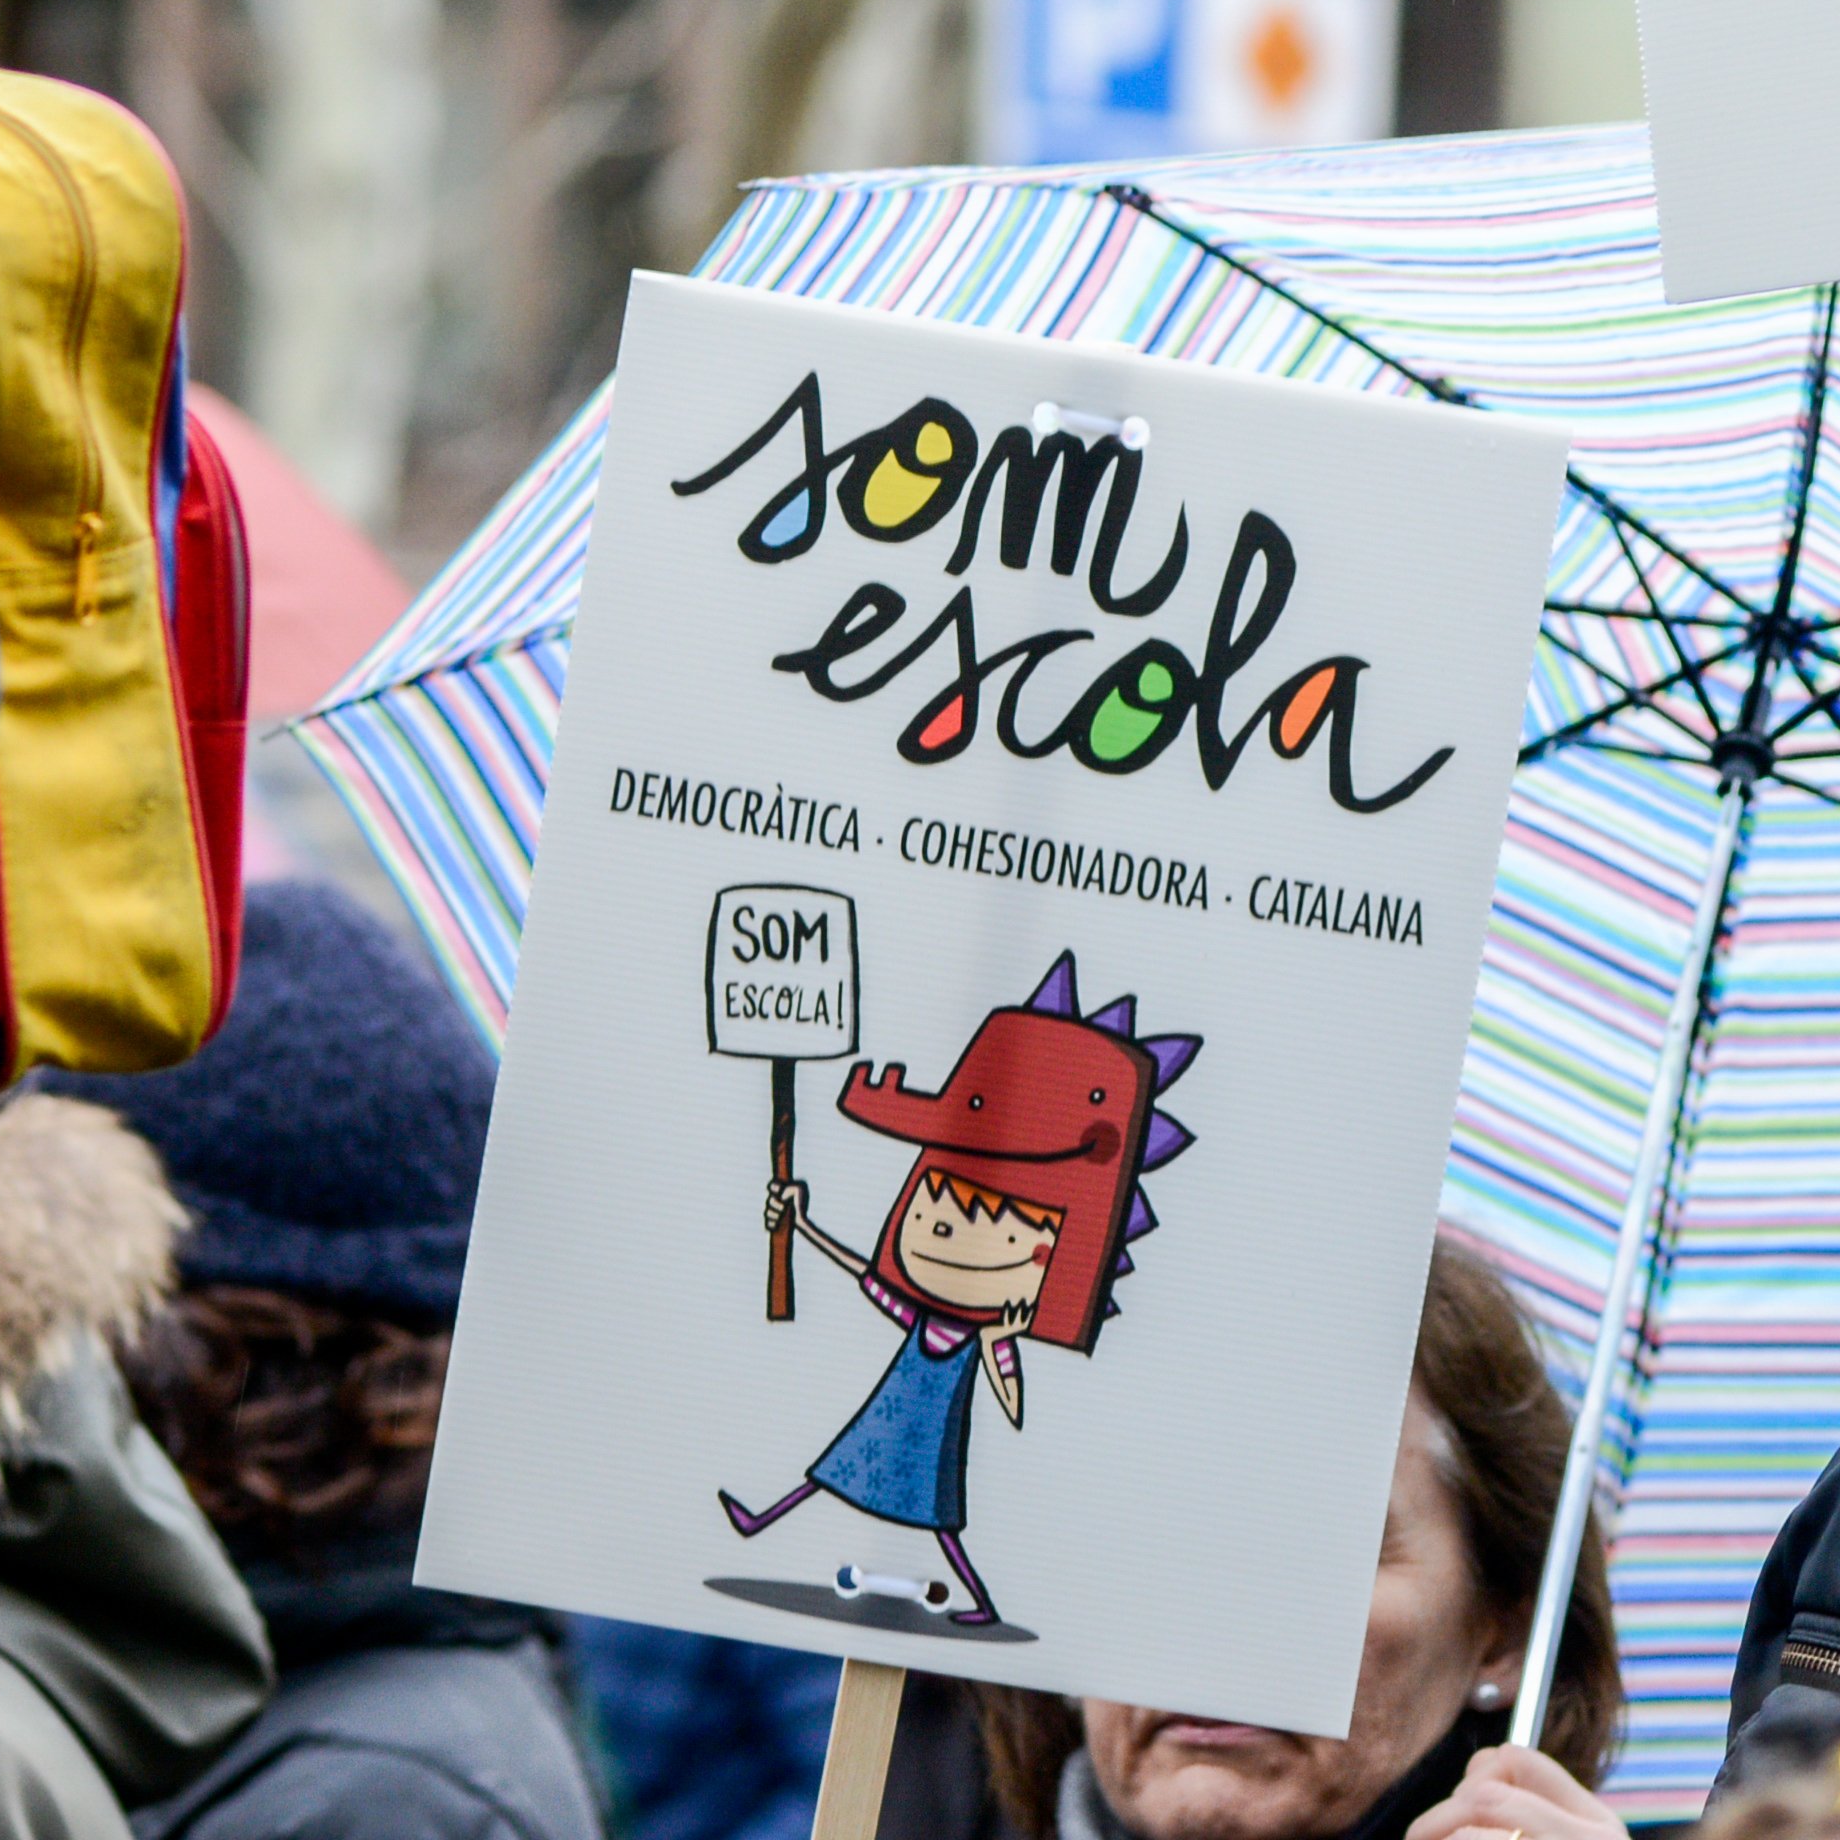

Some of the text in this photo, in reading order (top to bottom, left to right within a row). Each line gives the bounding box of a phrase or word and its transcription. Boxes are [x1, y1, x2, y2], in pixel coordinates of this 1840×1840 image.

[670, 370, 1190, 617] som
[771, 509, 1456, 813] escola
[610, 768, 1423, 946] DEMOCRÀTICA COHESIONADORA CATALANA
[732, 905, 829, 964] SOM
[725, 980, 844, 1030] ESCOLA!
